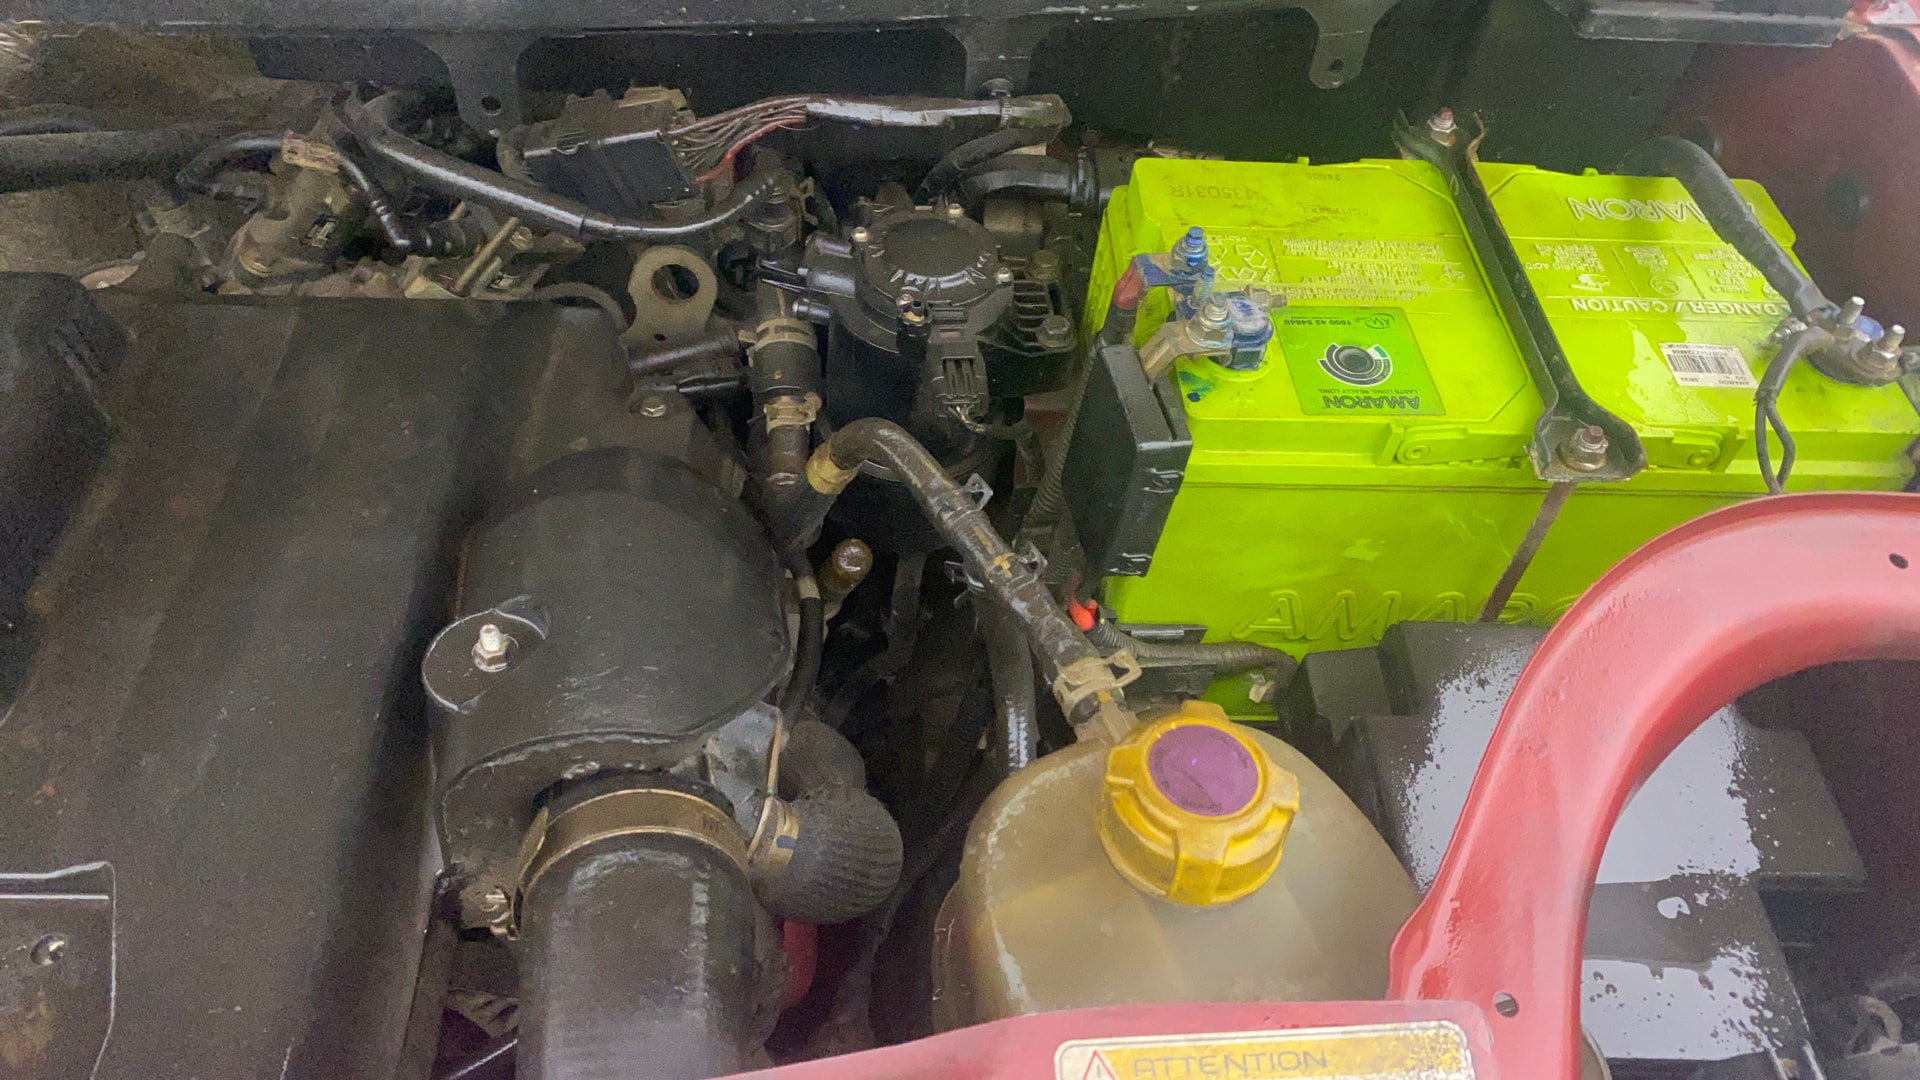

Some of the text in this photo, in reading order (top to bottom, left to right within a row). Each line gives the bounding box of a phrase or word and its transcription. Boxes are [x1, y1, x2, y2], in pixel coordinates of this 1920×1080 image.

[1571, 298, 1668, 313] CAUTION
[1689, 301, 1779, 315] DANGER
[1322, 395, 1420, 410] AMARON
[1133, 1049, 1328, 1078] ATTENTION
